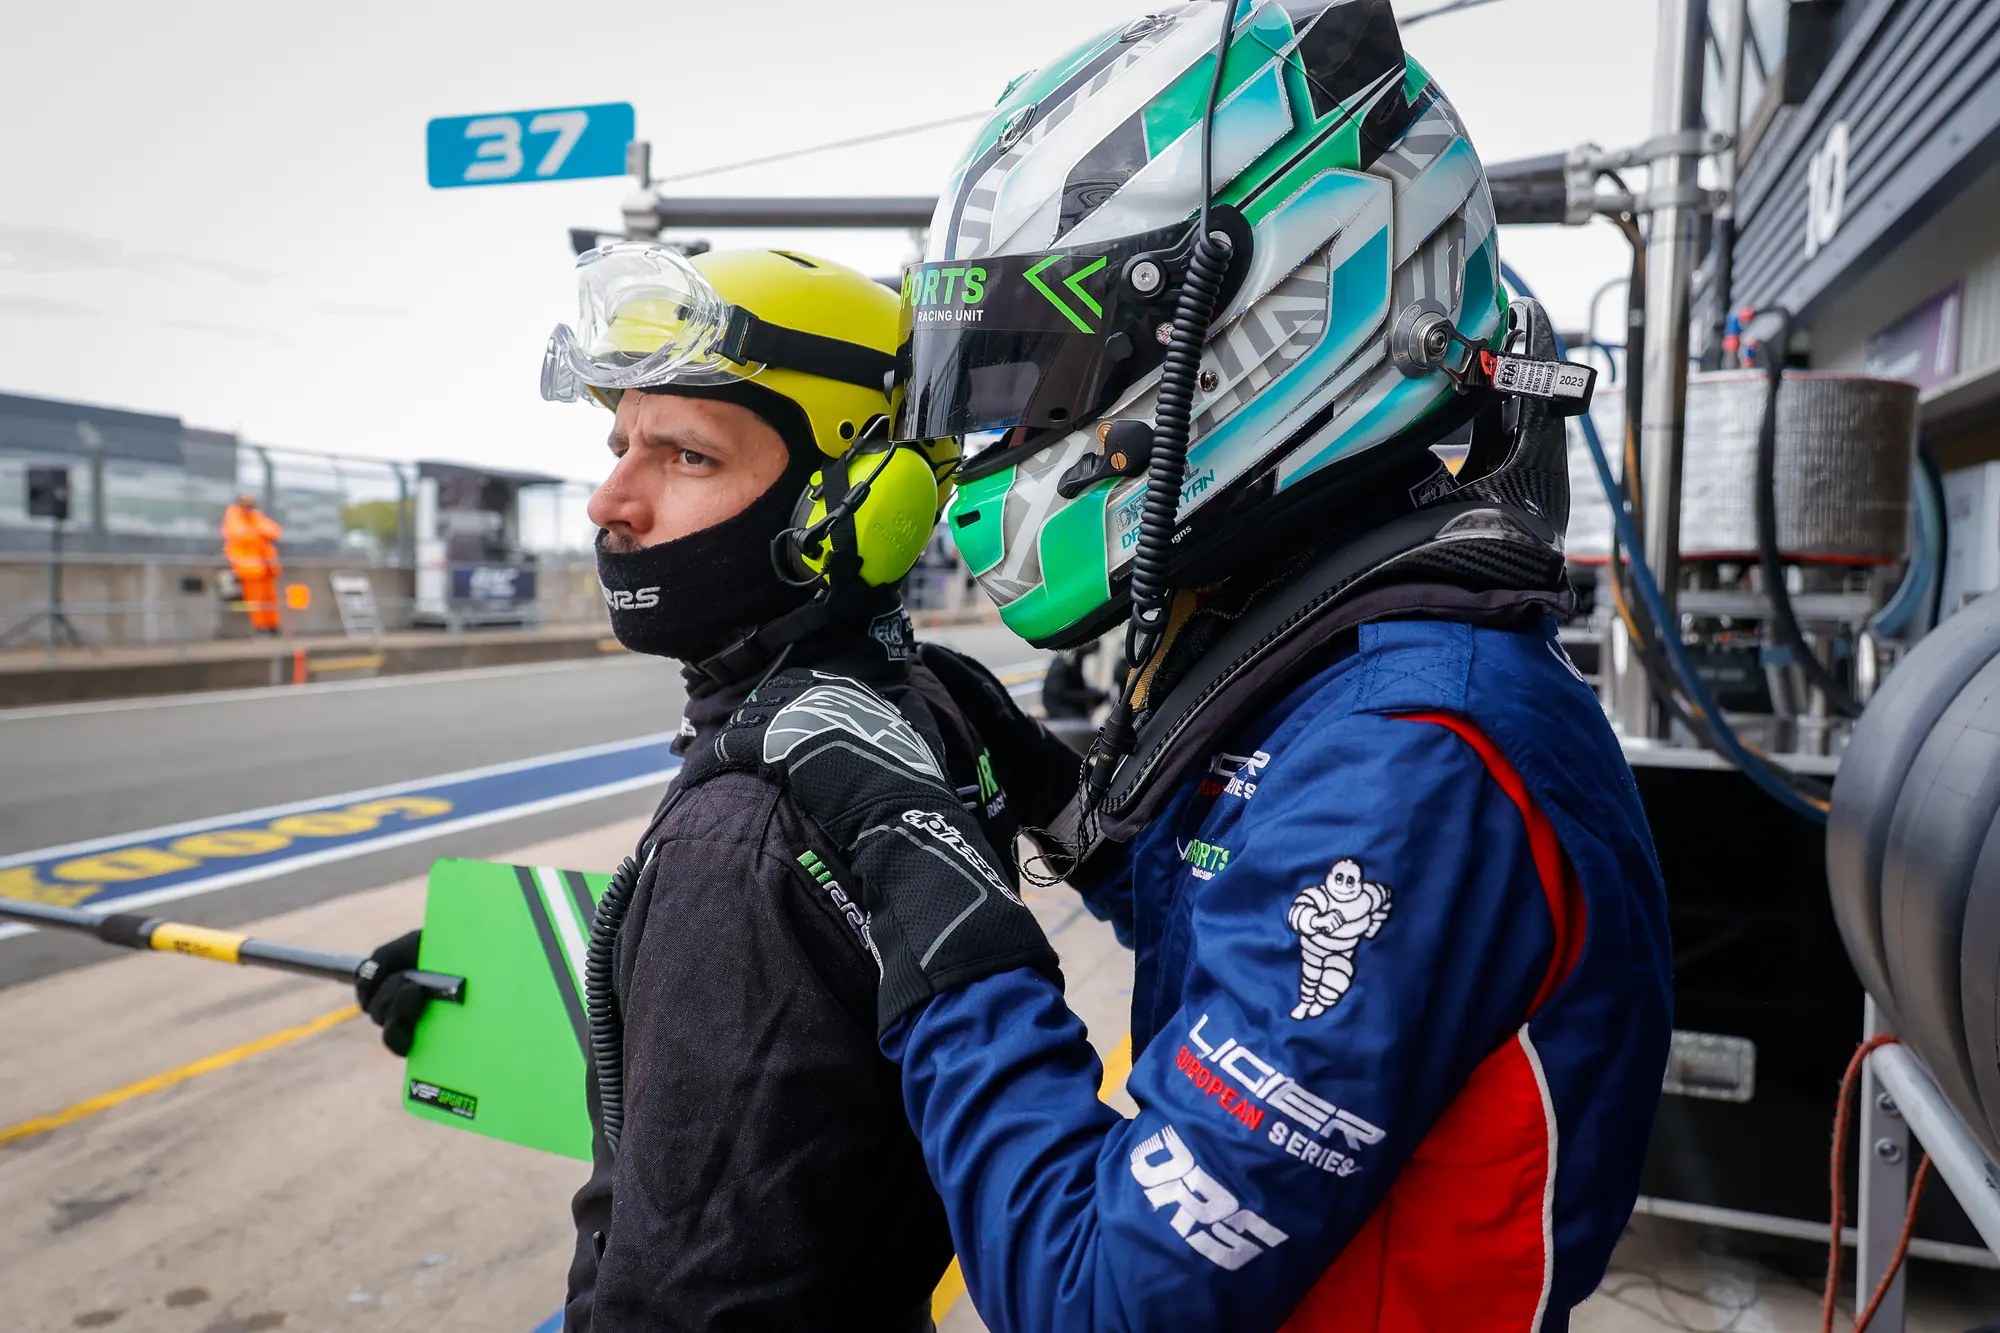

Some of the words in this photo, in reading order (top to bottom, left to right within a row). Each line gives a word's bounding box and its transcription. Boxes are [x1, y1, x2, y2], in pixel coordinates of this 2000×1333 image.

[463, 110, 589, 182] 37
[1803, 120, 1849, 259] 10
[917, 310, 953, 323] RACING
[955, 309, 984, 322] UNIT
[1559, 375, 1585, 388] 2023
[1175, 1045, 1265, 1132] EUROPEAN
[1267, 1121, 1363, 1178] SERIES
[1189, 1013, 1388, 1152] LIGIER
